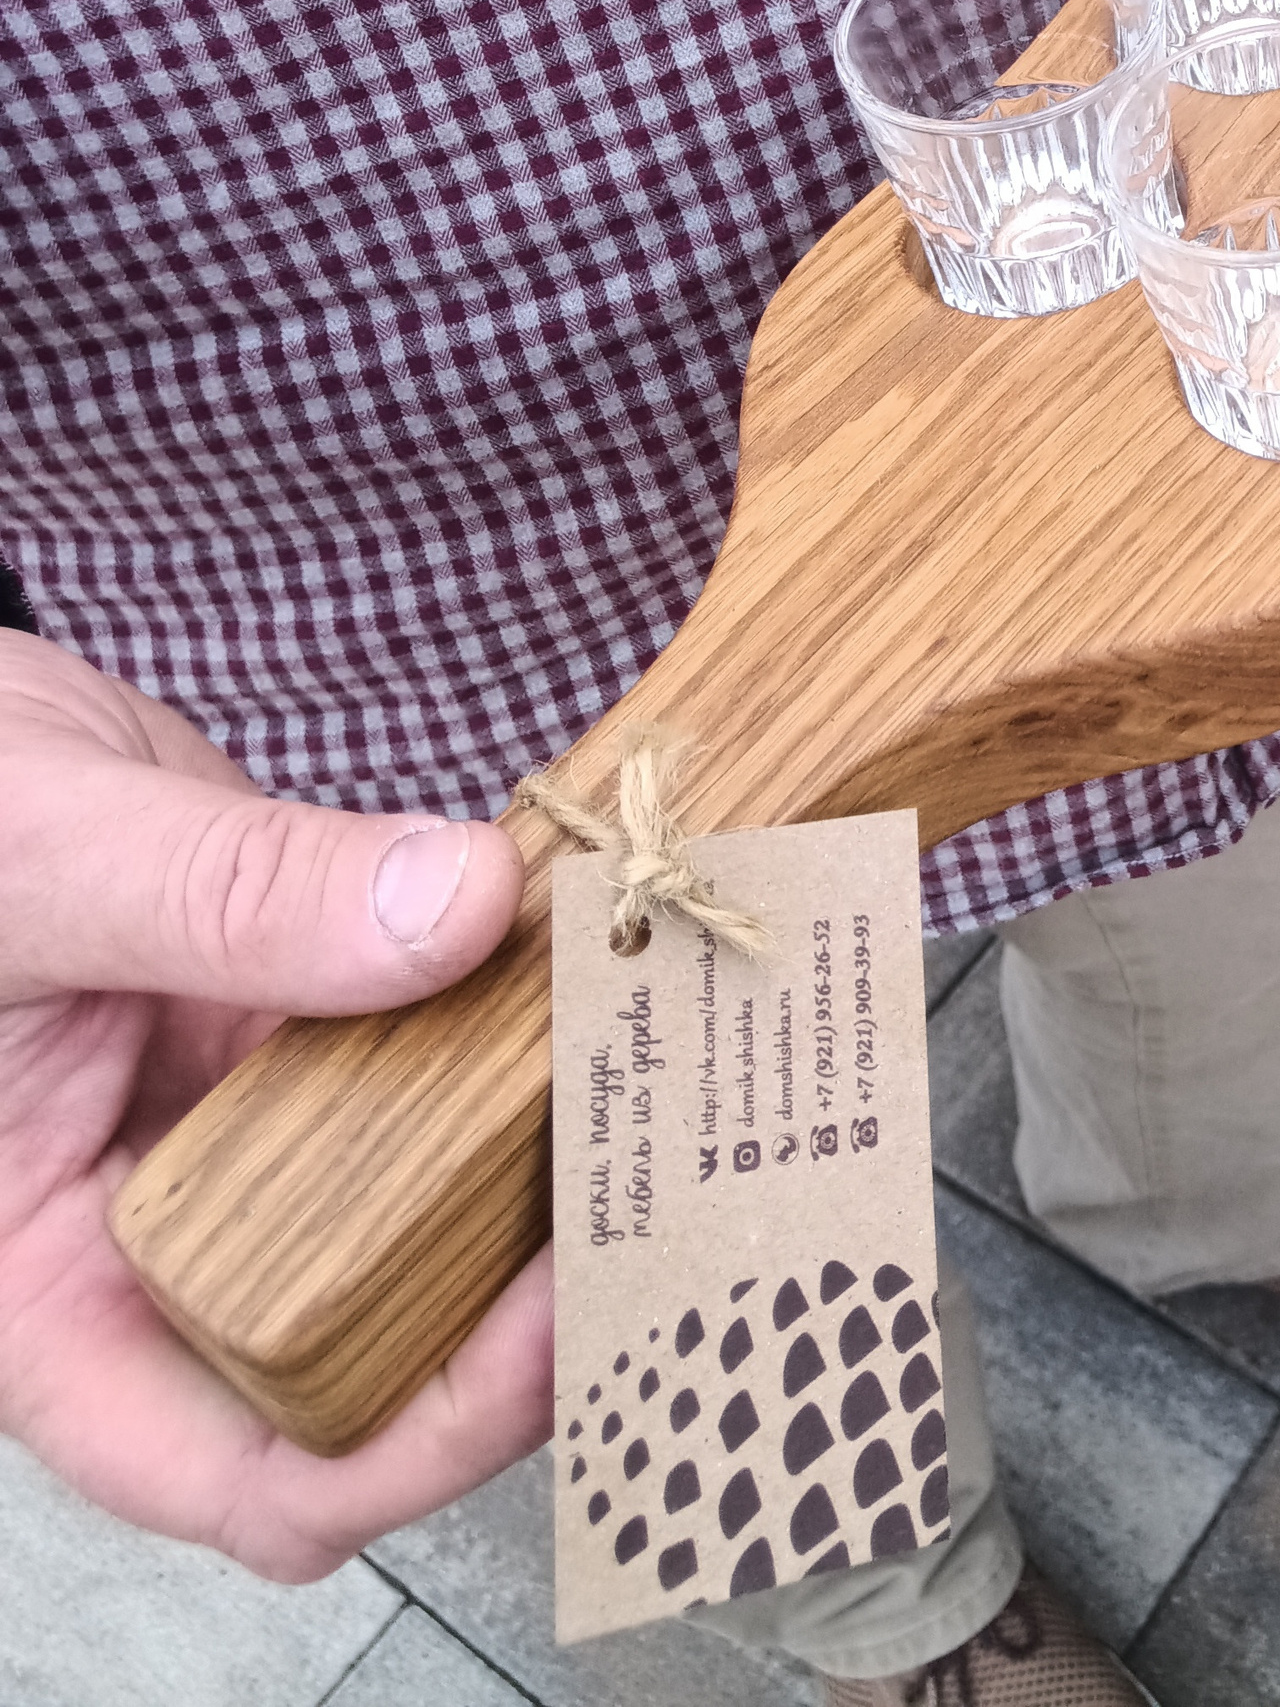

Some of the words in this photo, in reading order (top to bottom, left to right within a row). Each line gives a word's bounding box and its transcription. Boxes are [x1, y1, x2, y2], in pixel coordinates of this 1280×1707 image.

[813, 919, 833, 1022] 956-26-52
[853, 913, 873, 1015] 909-39-93
[617, 985, 666, 1074] дерева
[735, 997, 757, 1128] domik_shishka
[774, 988, 794, 1121] domshishka.ru
[814, 1025, 839, 1079] (921)
[854, 1019, 879, 1072] (921)
[631, 1085, 652, 1124] из
[816, 1083, 834, 1112] +7
[857, 1076, 875, 1104] +7
[625, 1136, 652, 1238] мебель
